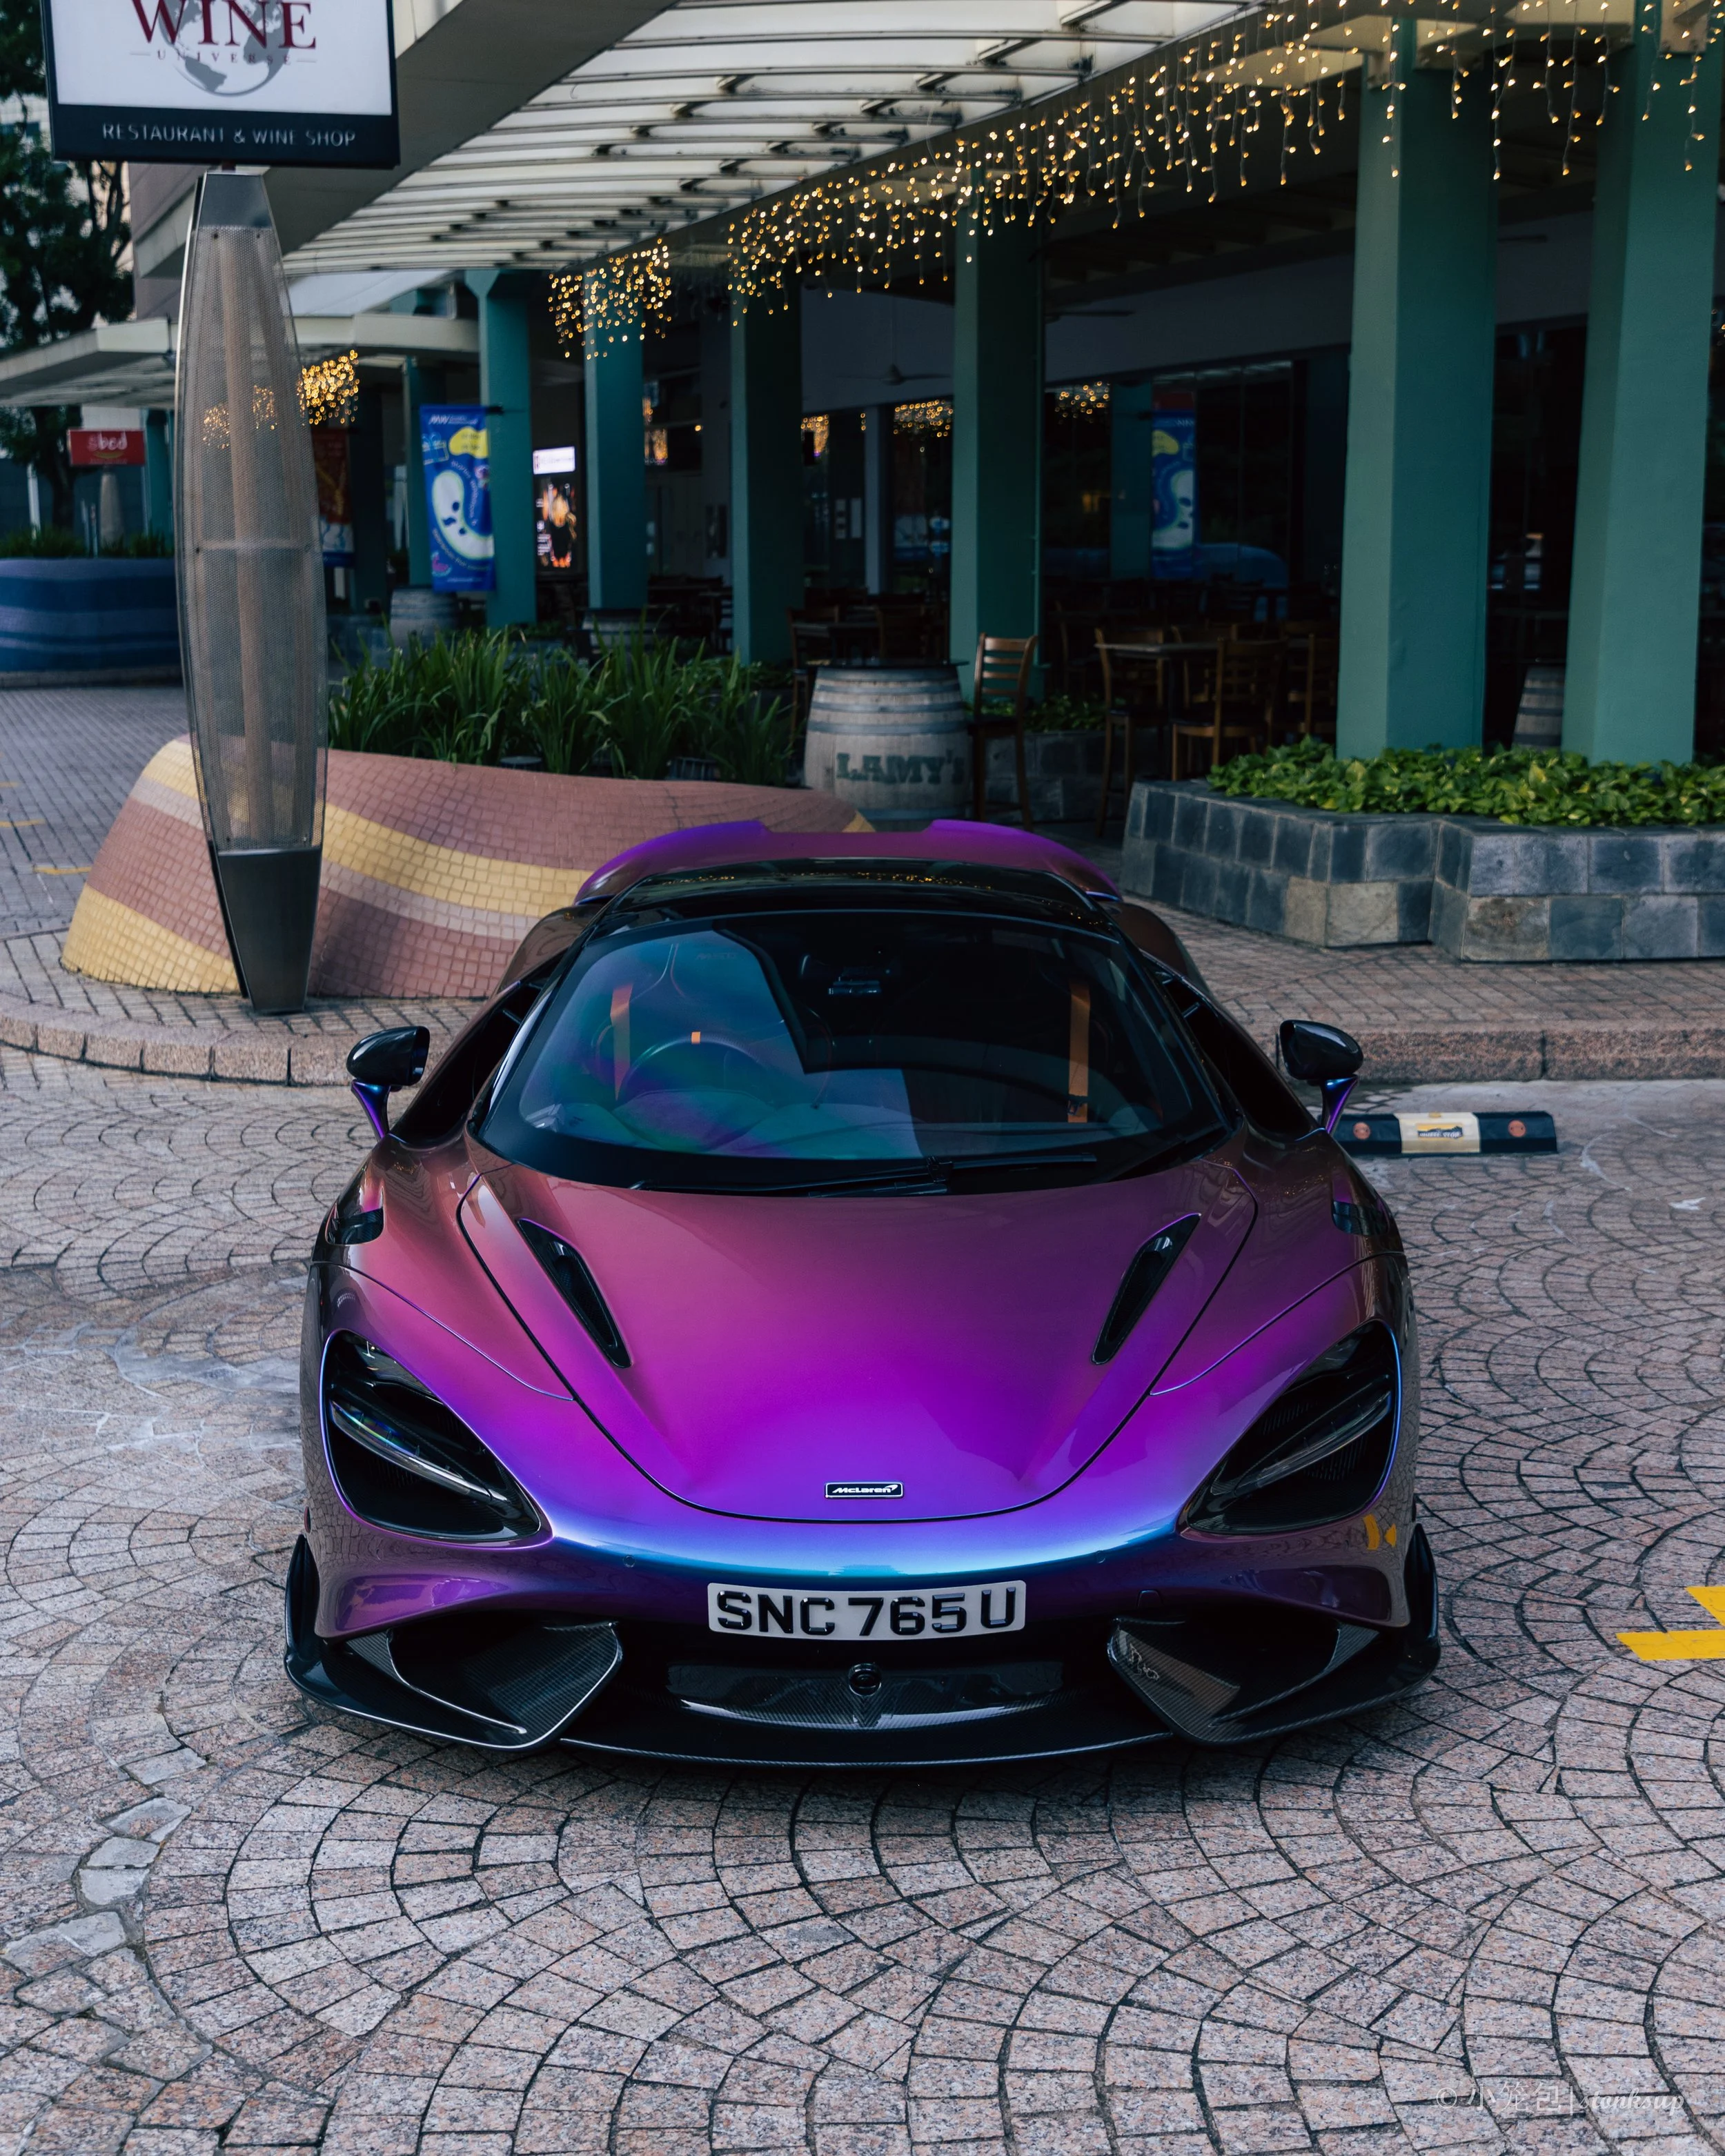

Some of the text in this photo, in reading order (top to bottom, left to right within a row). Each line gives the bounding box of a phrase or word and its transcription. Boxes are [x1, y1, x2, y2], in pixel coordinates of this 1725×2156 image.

[131, 0, 316, 49] WINE
[157, 50, 292, 66] UNIVERSE
[103, 123, 356, 147] RESTAURANT & WINE SHOP
